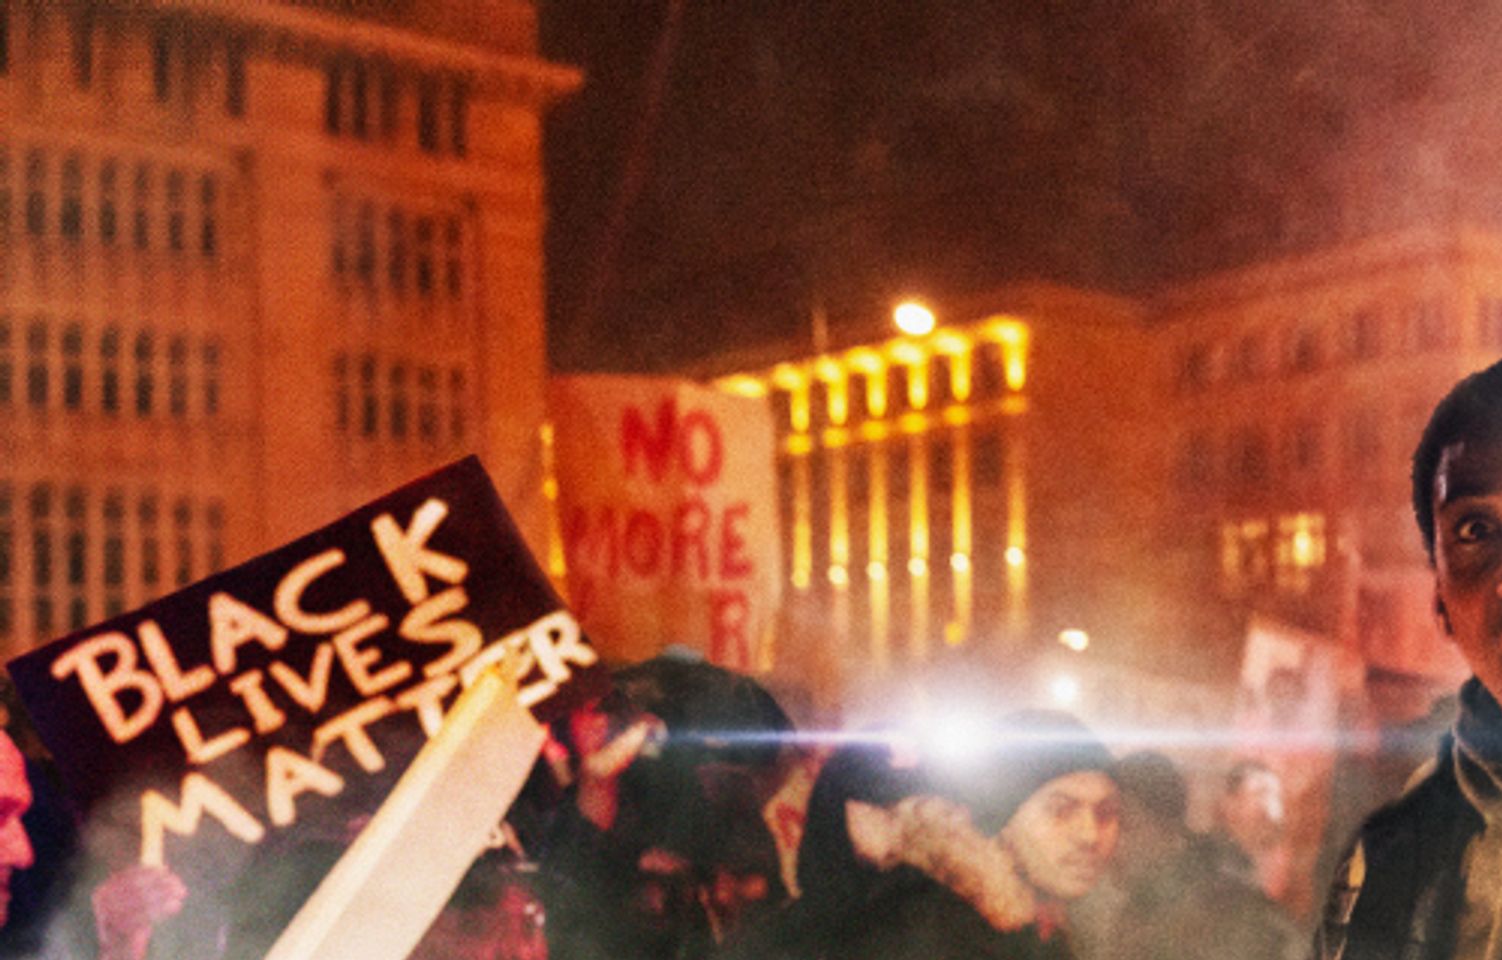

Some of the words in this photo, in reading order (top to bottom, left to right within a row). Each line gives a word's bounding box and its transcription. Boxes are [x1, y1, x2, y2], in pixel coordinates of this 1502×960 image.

[619, 395, 724, 489] NO
[566, 500, 753, 581] MORE
[52, 497, 469, 744] BLACK
[171, 586, 484, 764] LIVES
